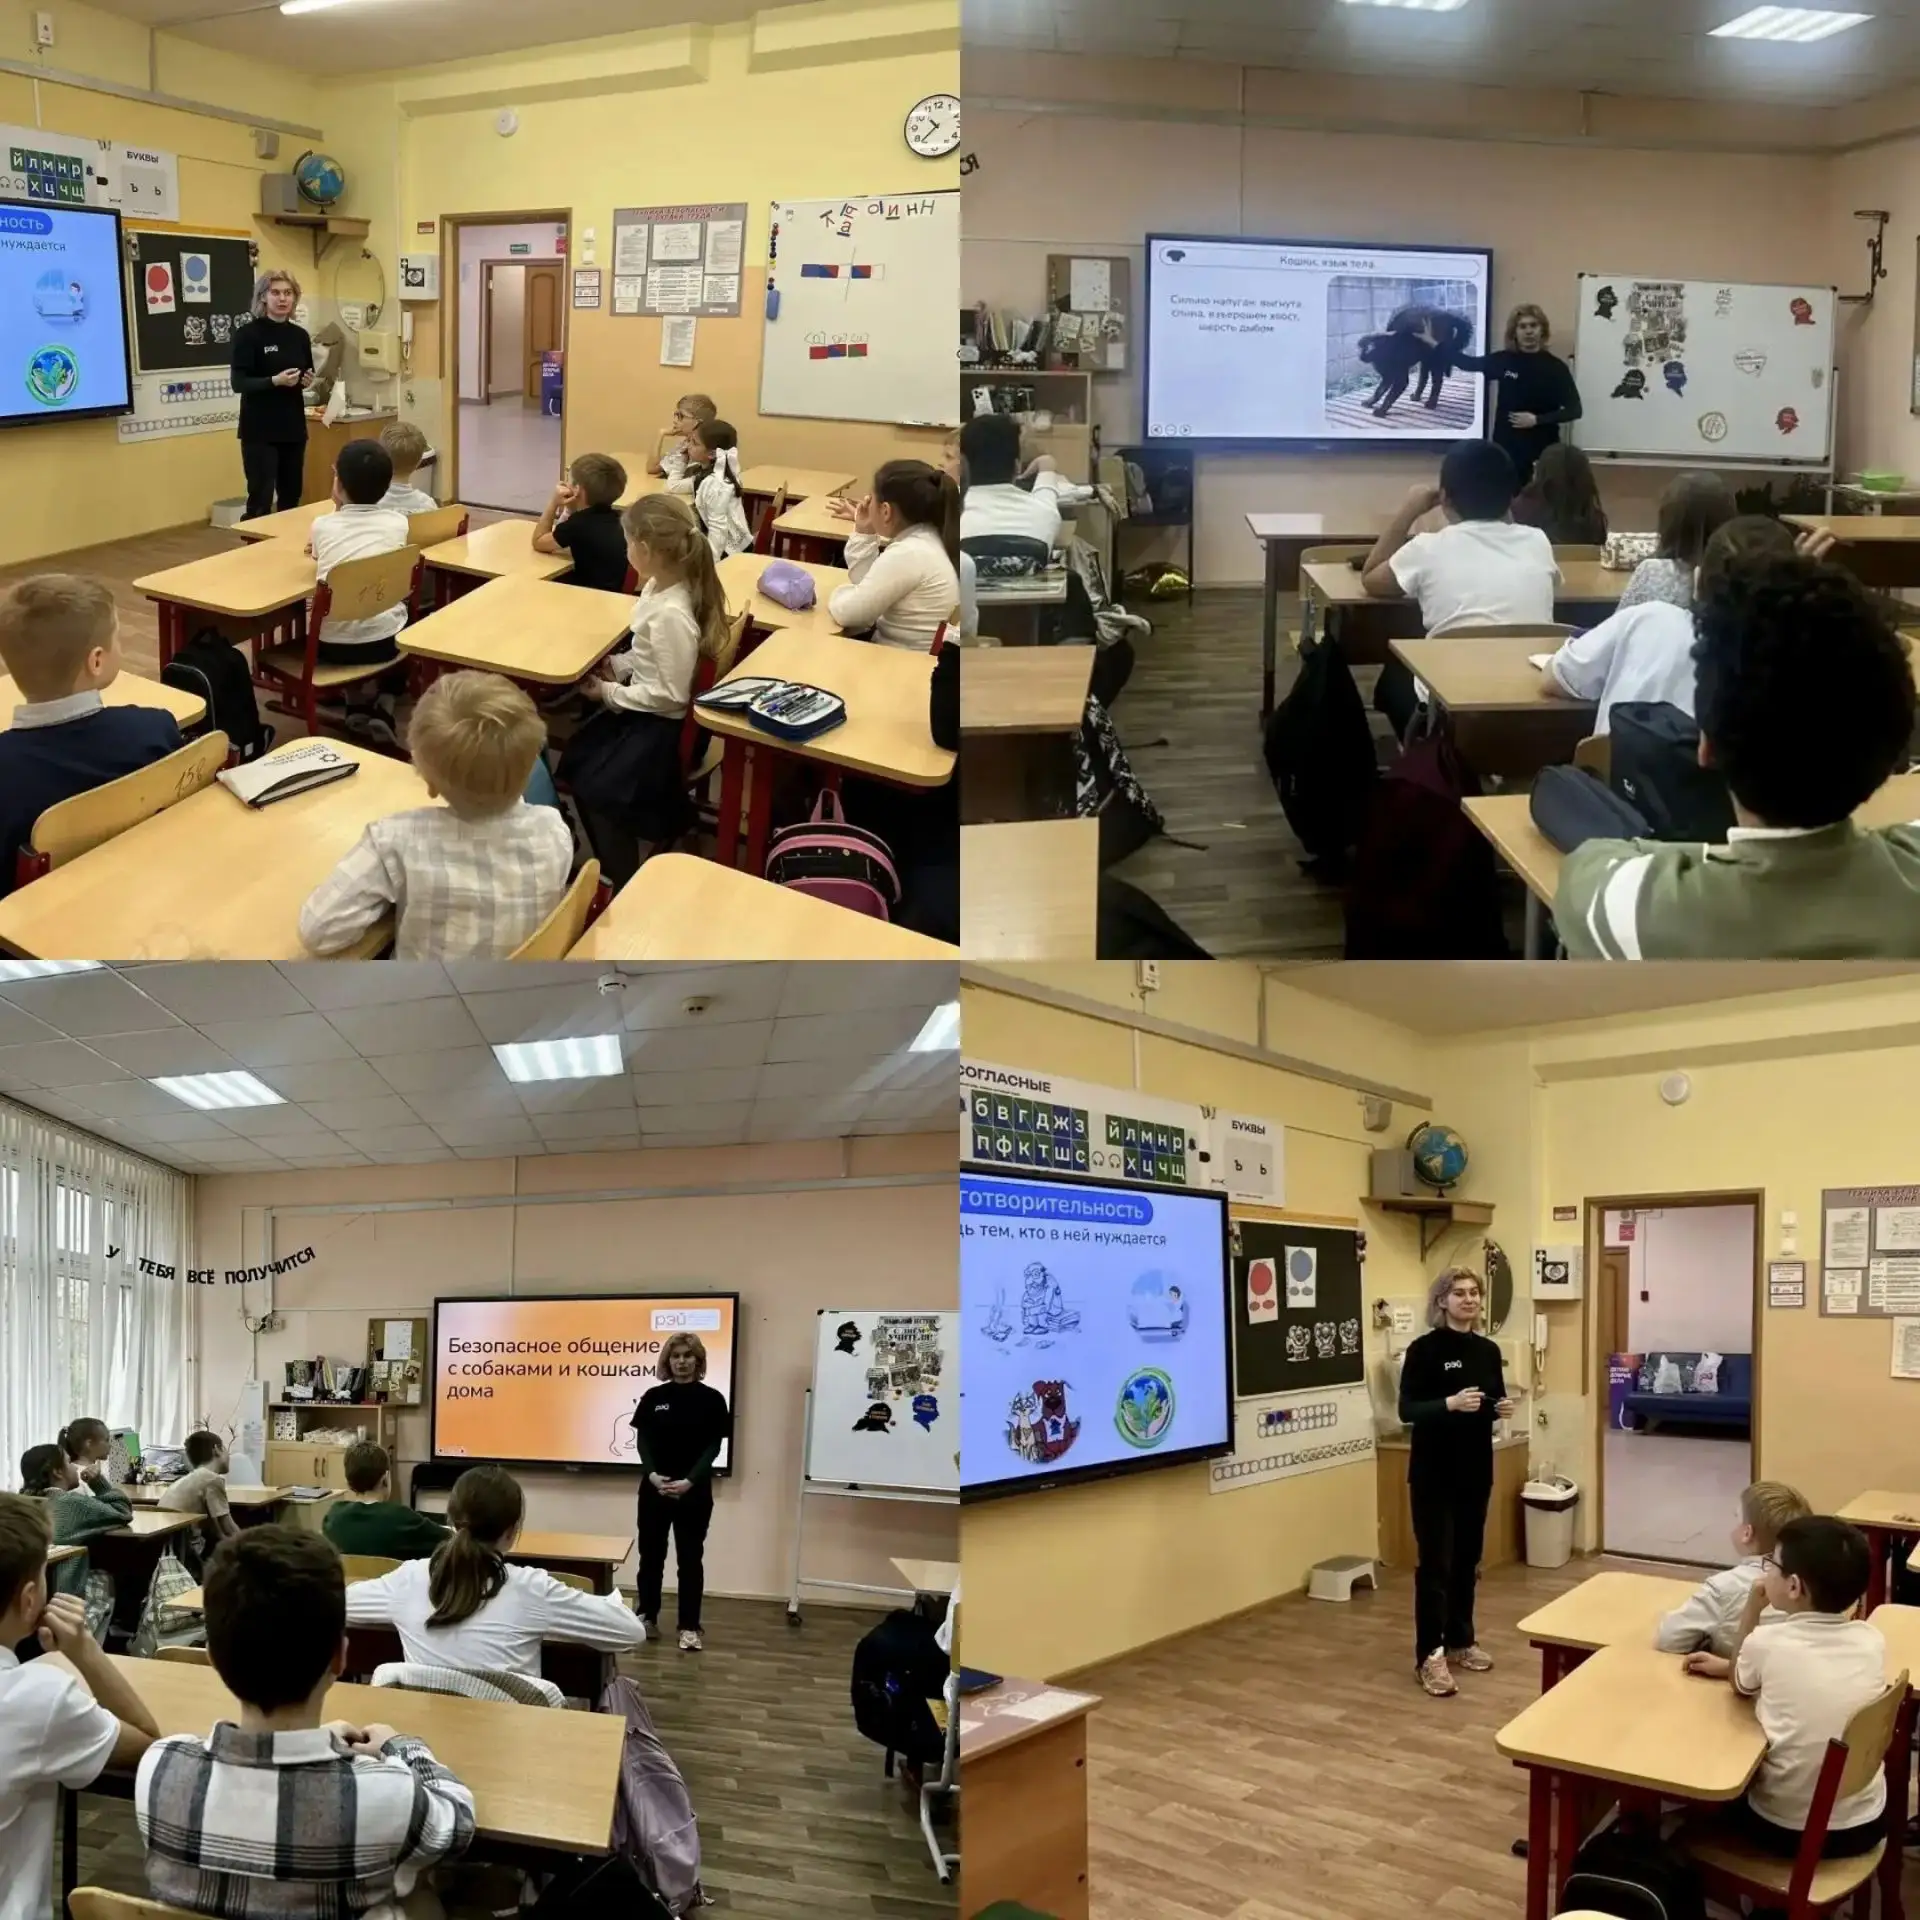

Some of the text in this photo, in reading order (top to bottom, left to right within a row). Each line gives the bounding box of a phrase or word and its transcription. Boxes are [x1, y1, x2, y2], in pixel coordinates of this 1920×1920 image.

[934, 101, 943, 109] 12
[13, 152, 81, 178] й л м н р
[126, 151, 159, 163] БУКВЫ
[0, 239, 66, 252] нуждается
[975, 1098, 1084, 1133] б в г д ж з
[1109, 1121, 1182, 1152] й л м н р
[1231, 1120, 1266, 1135] БУКВЫ
[977, 1135, 989, 1150] п
[996, 1135, 1012, 1157] ф
[1019, 1141, 1030, 1156] к
[1038, 1144, 1049, 1158] т
[1055, 1146, 1070, 1161] ш
[1126, 1157, 1185, 1179] х ц ч щ
[1234, 1159, 1267, 1175] ъ ь
[980, 1224, 1014, 1239] тем,
[1019, 1227, 1046, 1240] кто
[1051, 1230, 1059, 1240] в
[1063, 1228, 1090, 1242] ней
[1094, 1231, 1167, 1246] нуждается
[105, 1244, 316, 1285] У ТЕБЯ ВСЁ ПОЛУЧИТСЯ
[448, 1337, 660, 1357] Безопасное общение
[448, 1360, 657, 1377] с собаками и кошкам
[446, 1383, 494, 1400] дома
